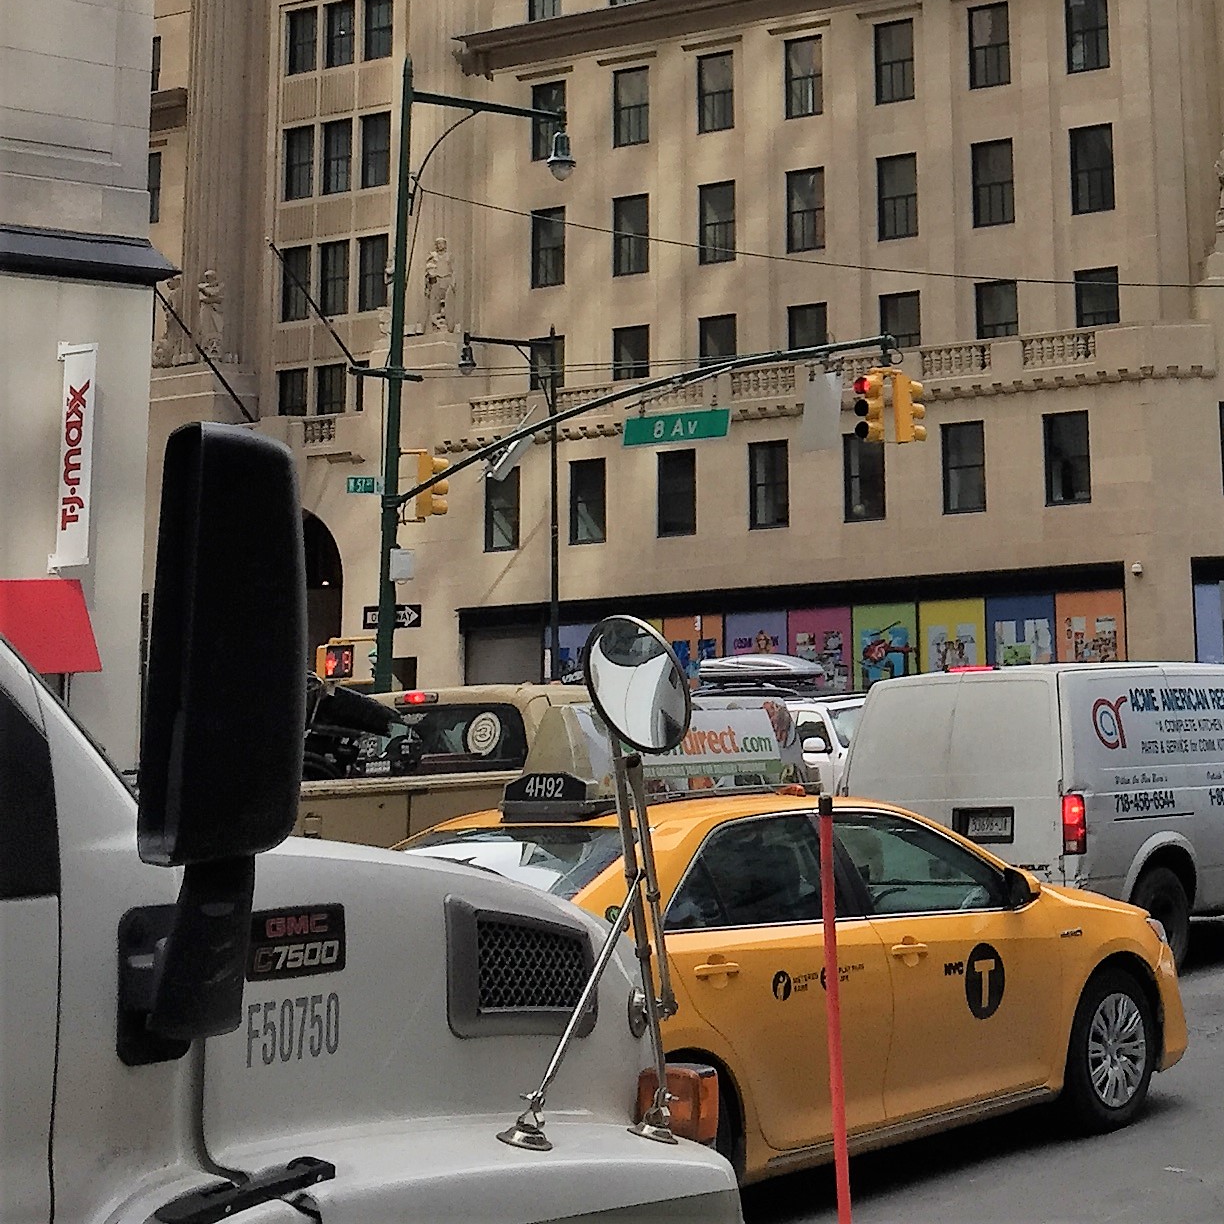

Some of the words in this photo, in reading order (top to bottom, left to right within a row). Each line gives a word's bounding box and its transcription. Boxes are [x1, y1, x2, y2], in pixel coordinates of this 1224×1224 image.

[653, 419, 666, 438] 8
[670, 417, 698, 437] Av
[1129, 688, 1159, 713] ACME
[1160, 687, 1210, 713] AMERICAN
[525, 776, 564, 798] 4H92
[265, 913, 328, 939] GMC
[254, 940, 339, 973] C7500
[944, 962, 964, 976] NYC
[246, 992, 339, 1069] F50750
